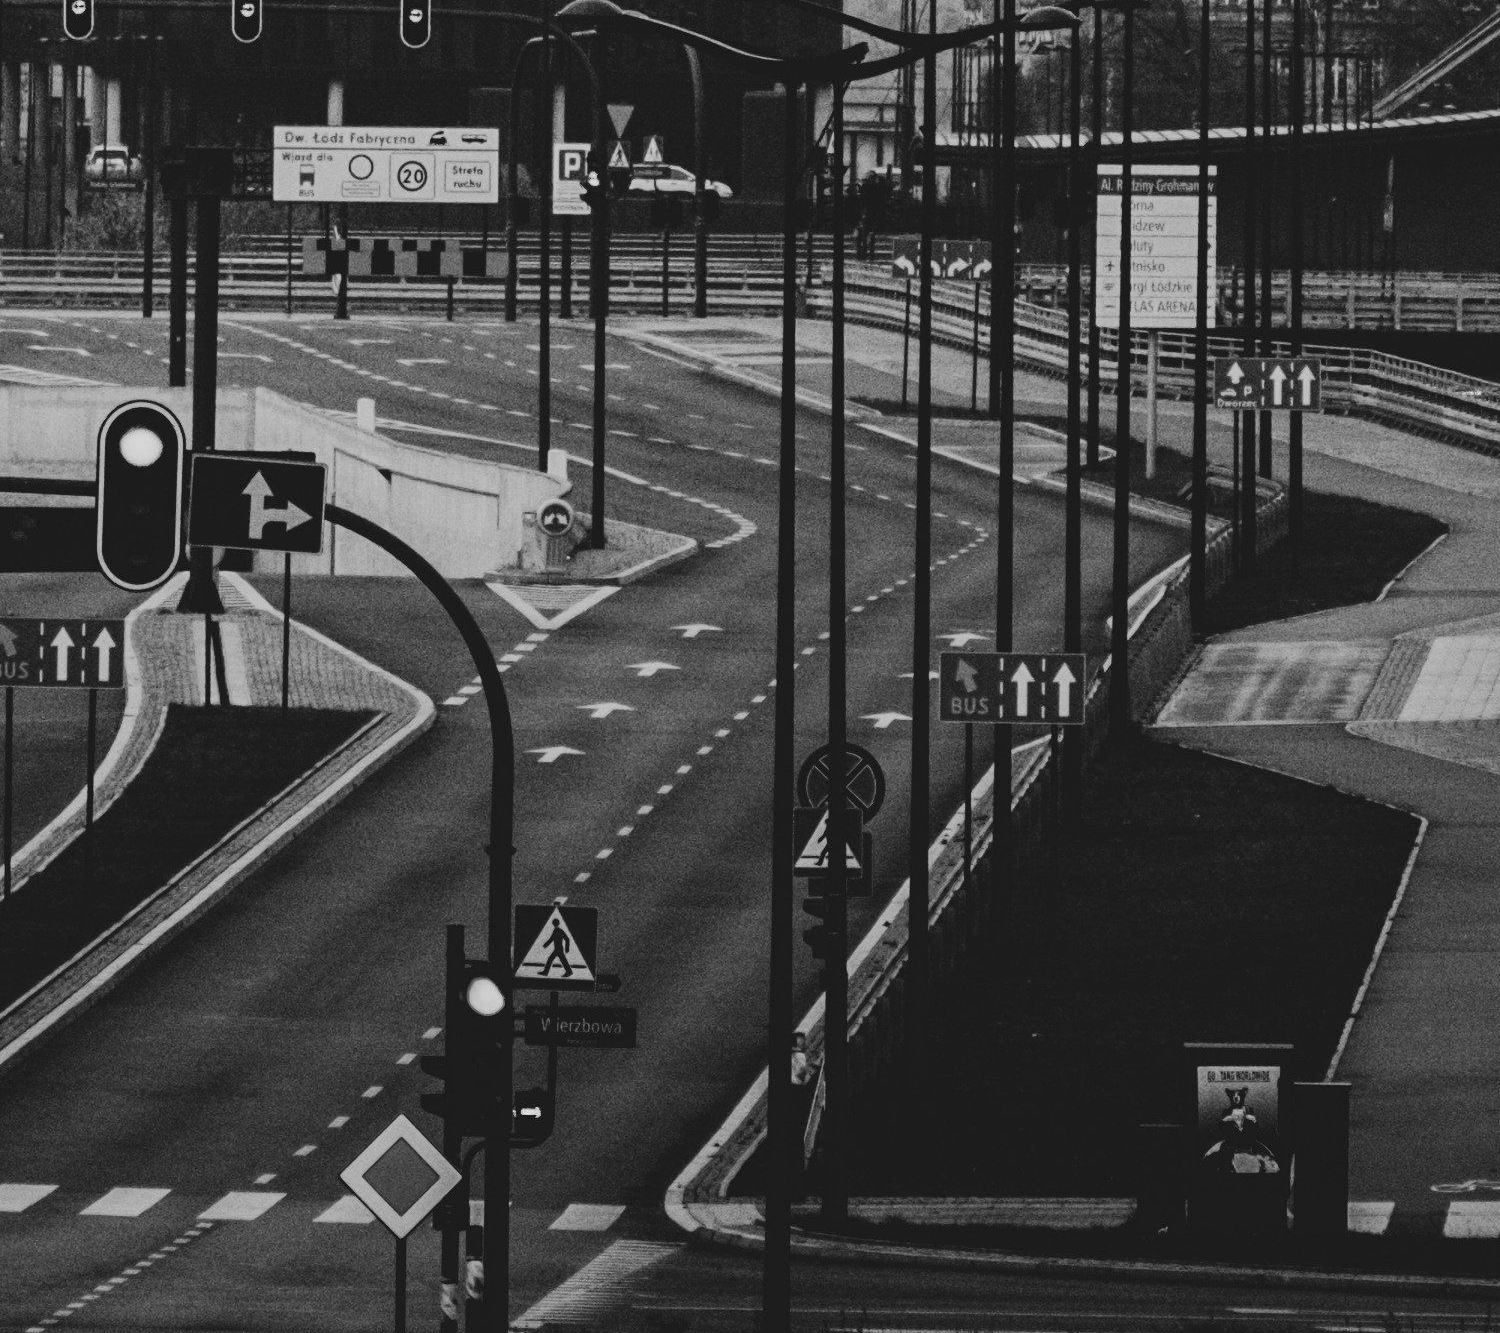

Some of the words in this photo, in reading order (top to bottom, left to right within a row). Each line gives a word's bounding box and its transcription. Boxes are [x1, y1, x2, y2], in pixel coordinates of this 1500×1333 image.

[350, 133, 416, 147] Fabryczna
[316, 152, 333, 162] dla
[403, 169, 424, 184] 20
[452, 165, 484, 176] Strefa
[453, 179, 482, 189] ruchu
[1101, 177, 1113, 191] Al.
[1156, 178, 1214, 194] Grohmanw
[1132, 220, 1166, 233] idzew
[1132, 259, 1166, 273] tnisko
[1157, 300, 1196, 314] ARENA
[951, 696, 990, 715] BUS
[540, 1016, 623, 1034] Wierzbowa
